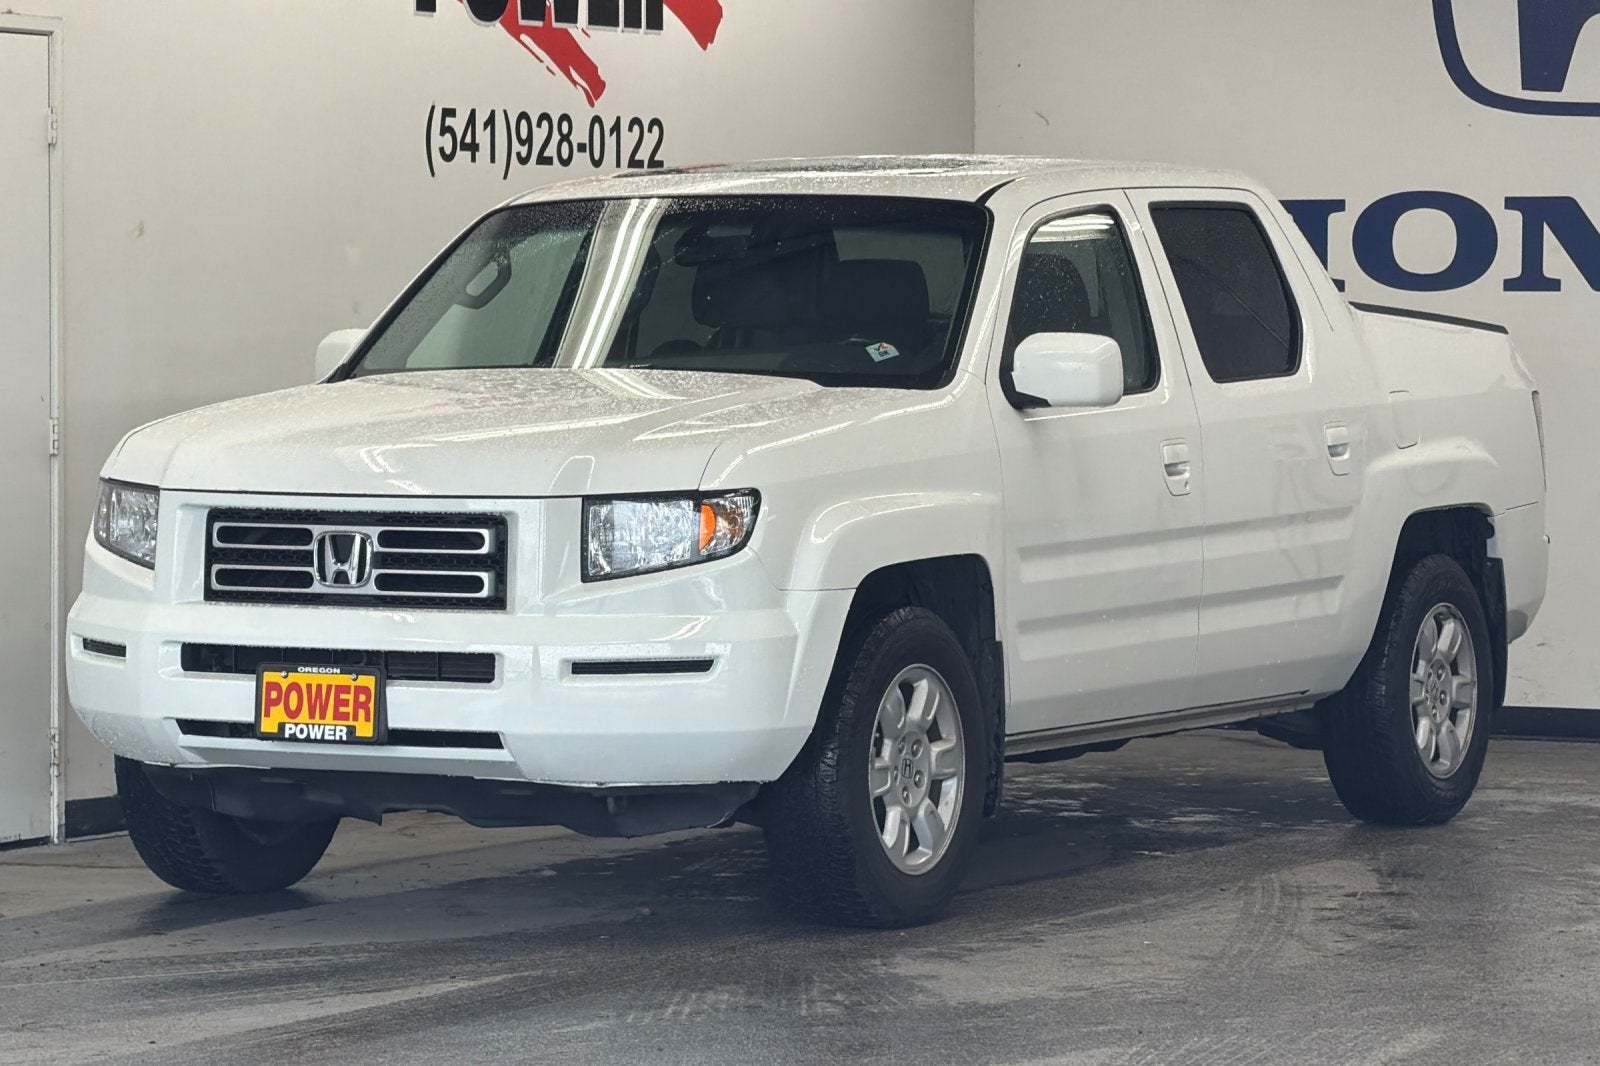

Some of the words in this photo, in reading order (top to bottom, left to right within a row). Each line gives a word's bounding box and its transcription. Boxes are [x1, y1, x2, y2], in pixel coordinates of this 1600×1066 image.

[425, 104, 665, 180] (541)928-0122
[1278, 190, 1600, 292] ON
[297, 666, 341, 674] OREGON
[263, 681, 372, 723] POWER
[284, 723, 348, 741] POWER
